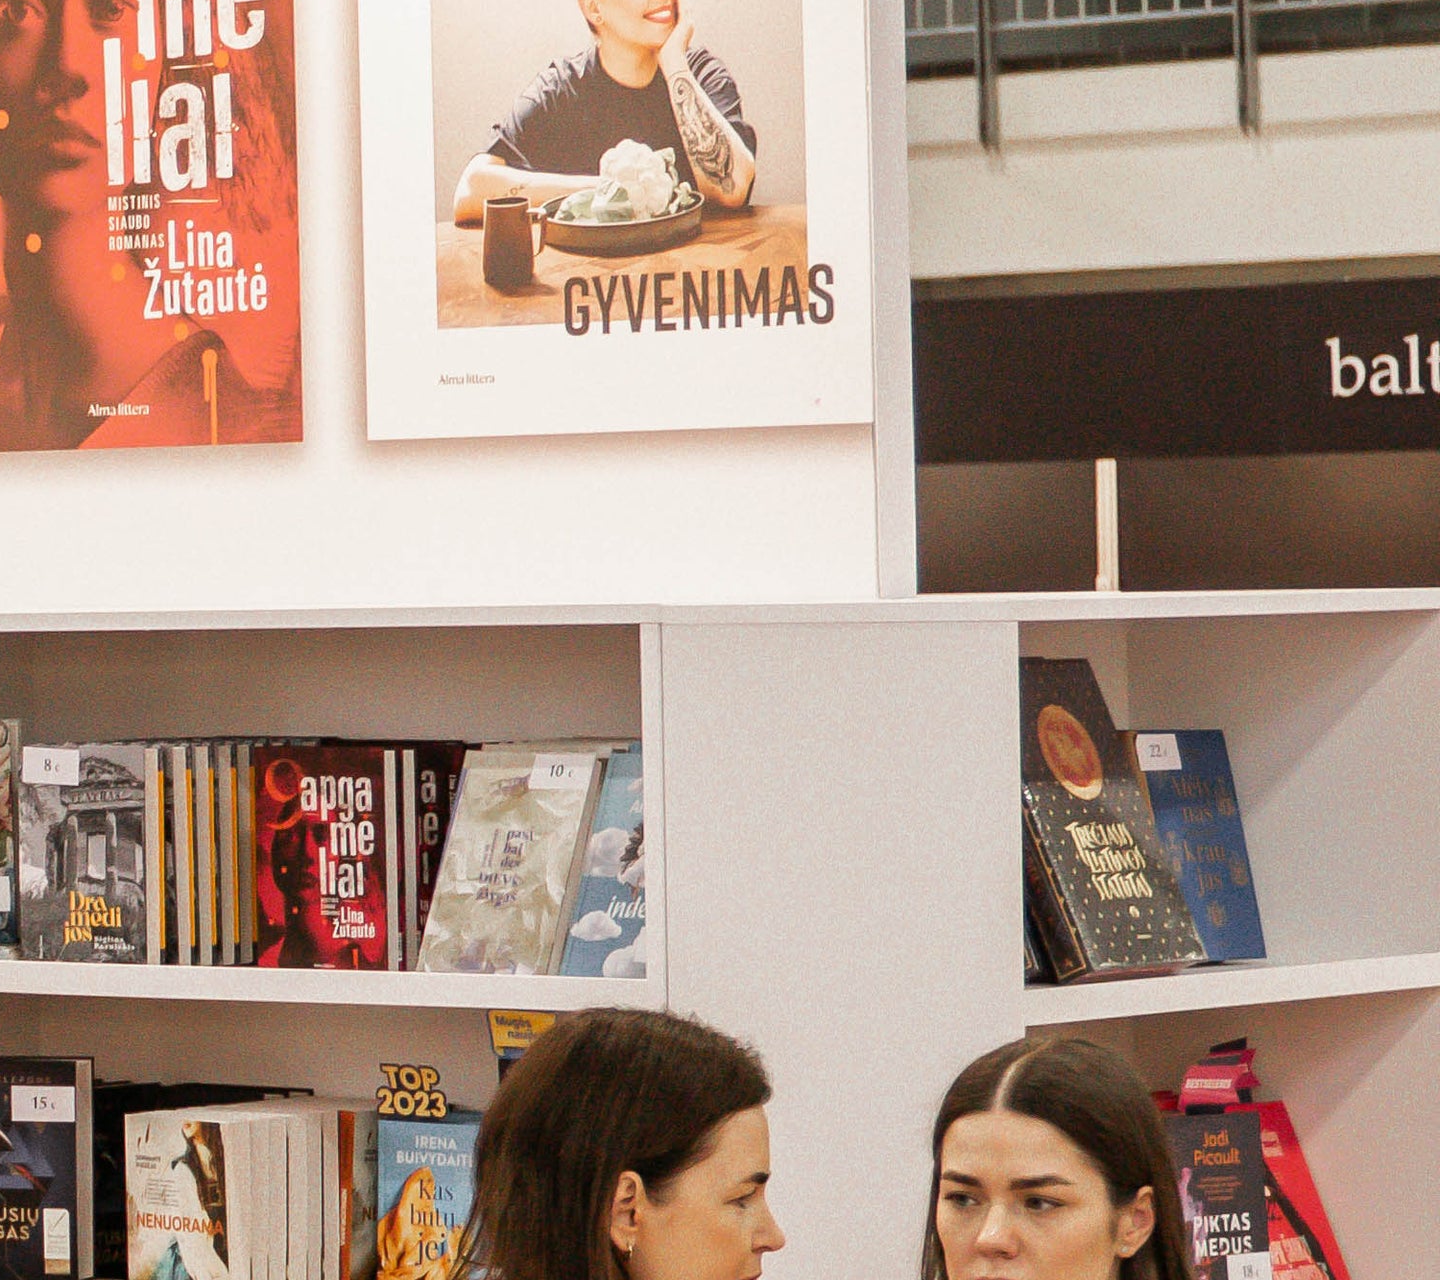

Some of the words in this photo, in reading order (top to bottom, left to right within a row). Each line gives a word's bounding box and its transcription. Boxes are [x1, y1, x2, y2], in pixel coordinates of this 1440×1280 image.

[108, 193, 161, 212] MISTINIS
[108, 214, 151, 231] SIAUBO
[108, 233, 165, 251] ROMANAS
[167, 219, 234, 270] Lina
[143, 257, 268, 320] Žutautė
[563, 262, 836, 336] GYVENIMAS
[87, 404, 117, 417] Alma
[118, 402, 150, 416] littera
[549, 764, 564, 777] 10
[300, 775, 373, 822] apga
[69, 890, 106, 911] Dra
[70, 905, 122, 928] medi
[340, 906, 365, 924] Lina
[63, 920, 93, 945] jos
[332, 918, 376, 939] Žutautė
[381, 1064, 440, 1091] TOP
[32, 1095, 48, 1110] 15
[377, 1089, 447, 1118] 2023
[414, 1135, 458, 1150] IRENA
[1202, 1130, 1230, 1150] Jodi
[1193, 1146, 1241, 1167] Picoult
[136, 1210, 225, 1236] NENUORAMA
[1193, 1212, 1252, 1235] PIKTAS
[1195, 1236, 1253, 1259] MEDUS
